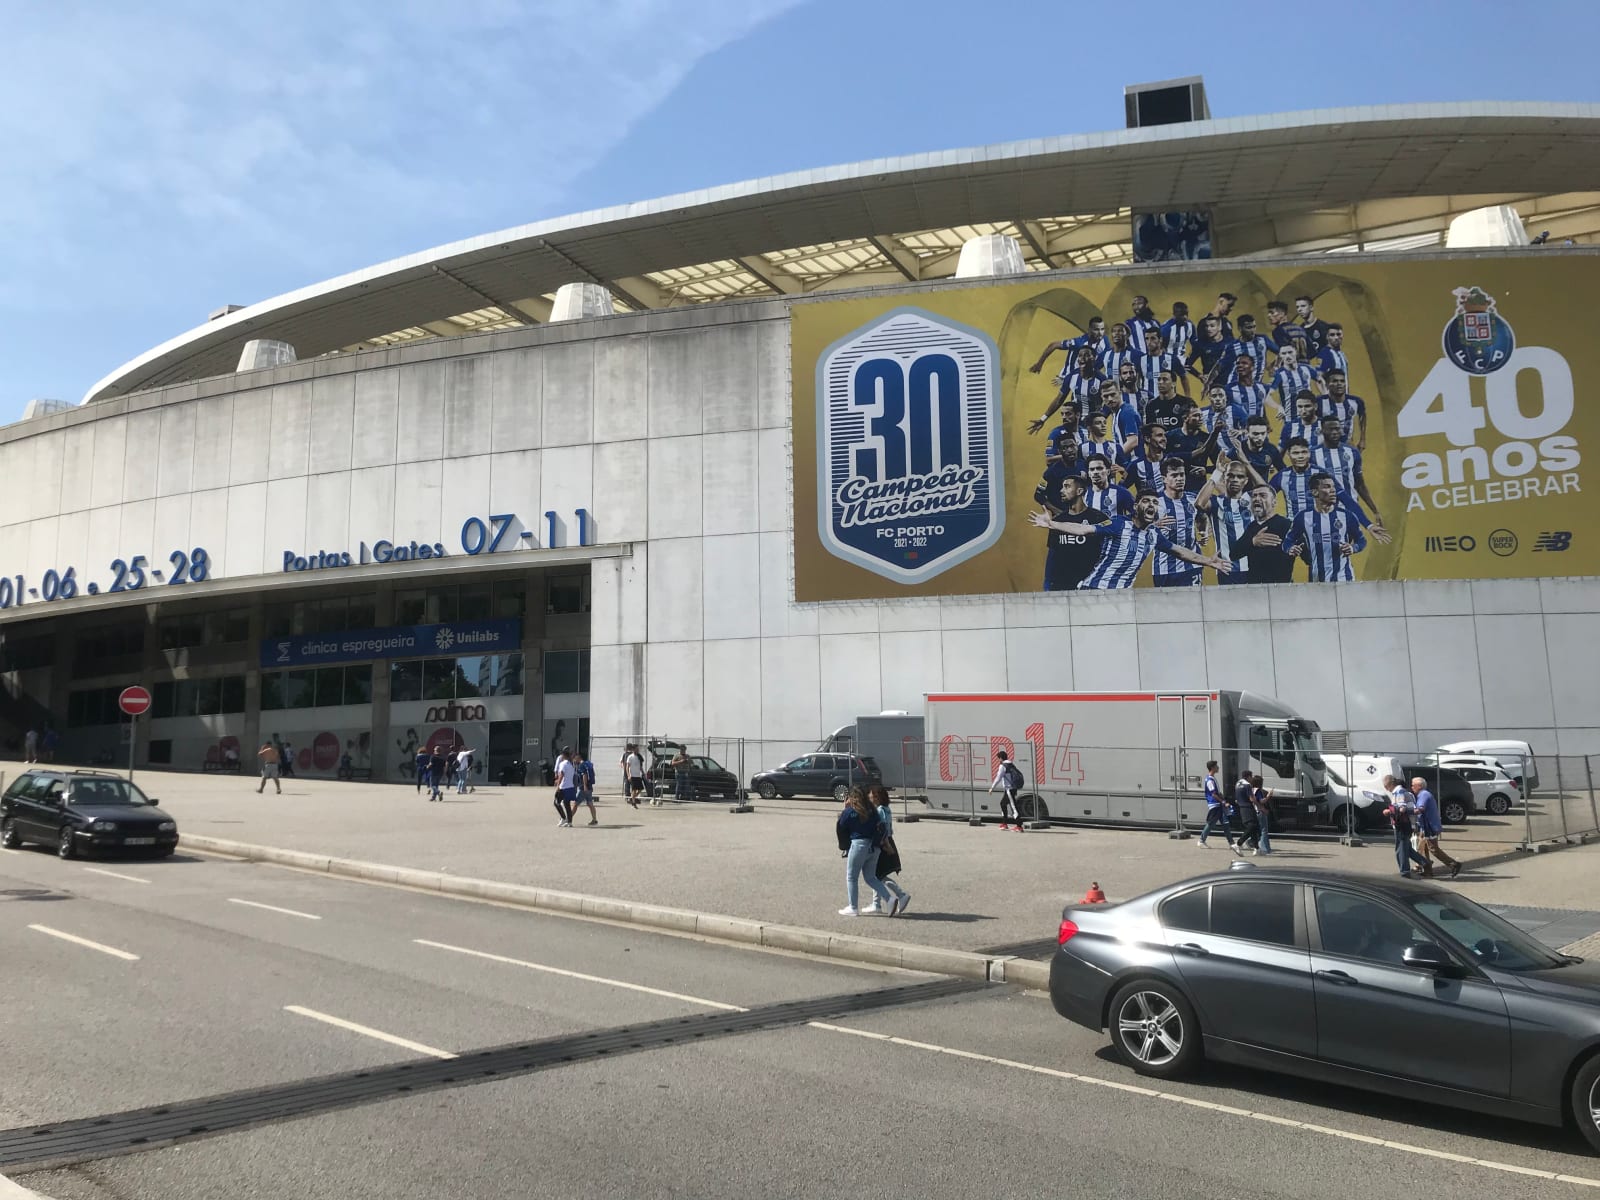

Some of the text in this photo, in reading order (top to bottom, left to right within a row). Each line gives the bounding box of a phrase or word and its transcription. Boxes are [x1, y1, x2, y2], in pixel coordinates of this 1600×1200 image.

[1396, 346, 1574, 447] 40
[854, 353, 962, 481] 30
[1400, 435, 1581, 489] anos
[840, 466, 982, 505] Campeão
[1406, 473, 1581, 513] A CELEBRAR
[843, 485, 972, 526] Nacional
[876, 525, 945, 538] FC PORTO
[1059, 534, 1086, 545] MEO
[1425, 535, 1476, 552] MEO
[283, 551, 350, 573] Portas
[373, 540, 443, 563] Gates
[342, 635, 415, 655] espregueira
[457, 630, 500, 645] Unilabs
